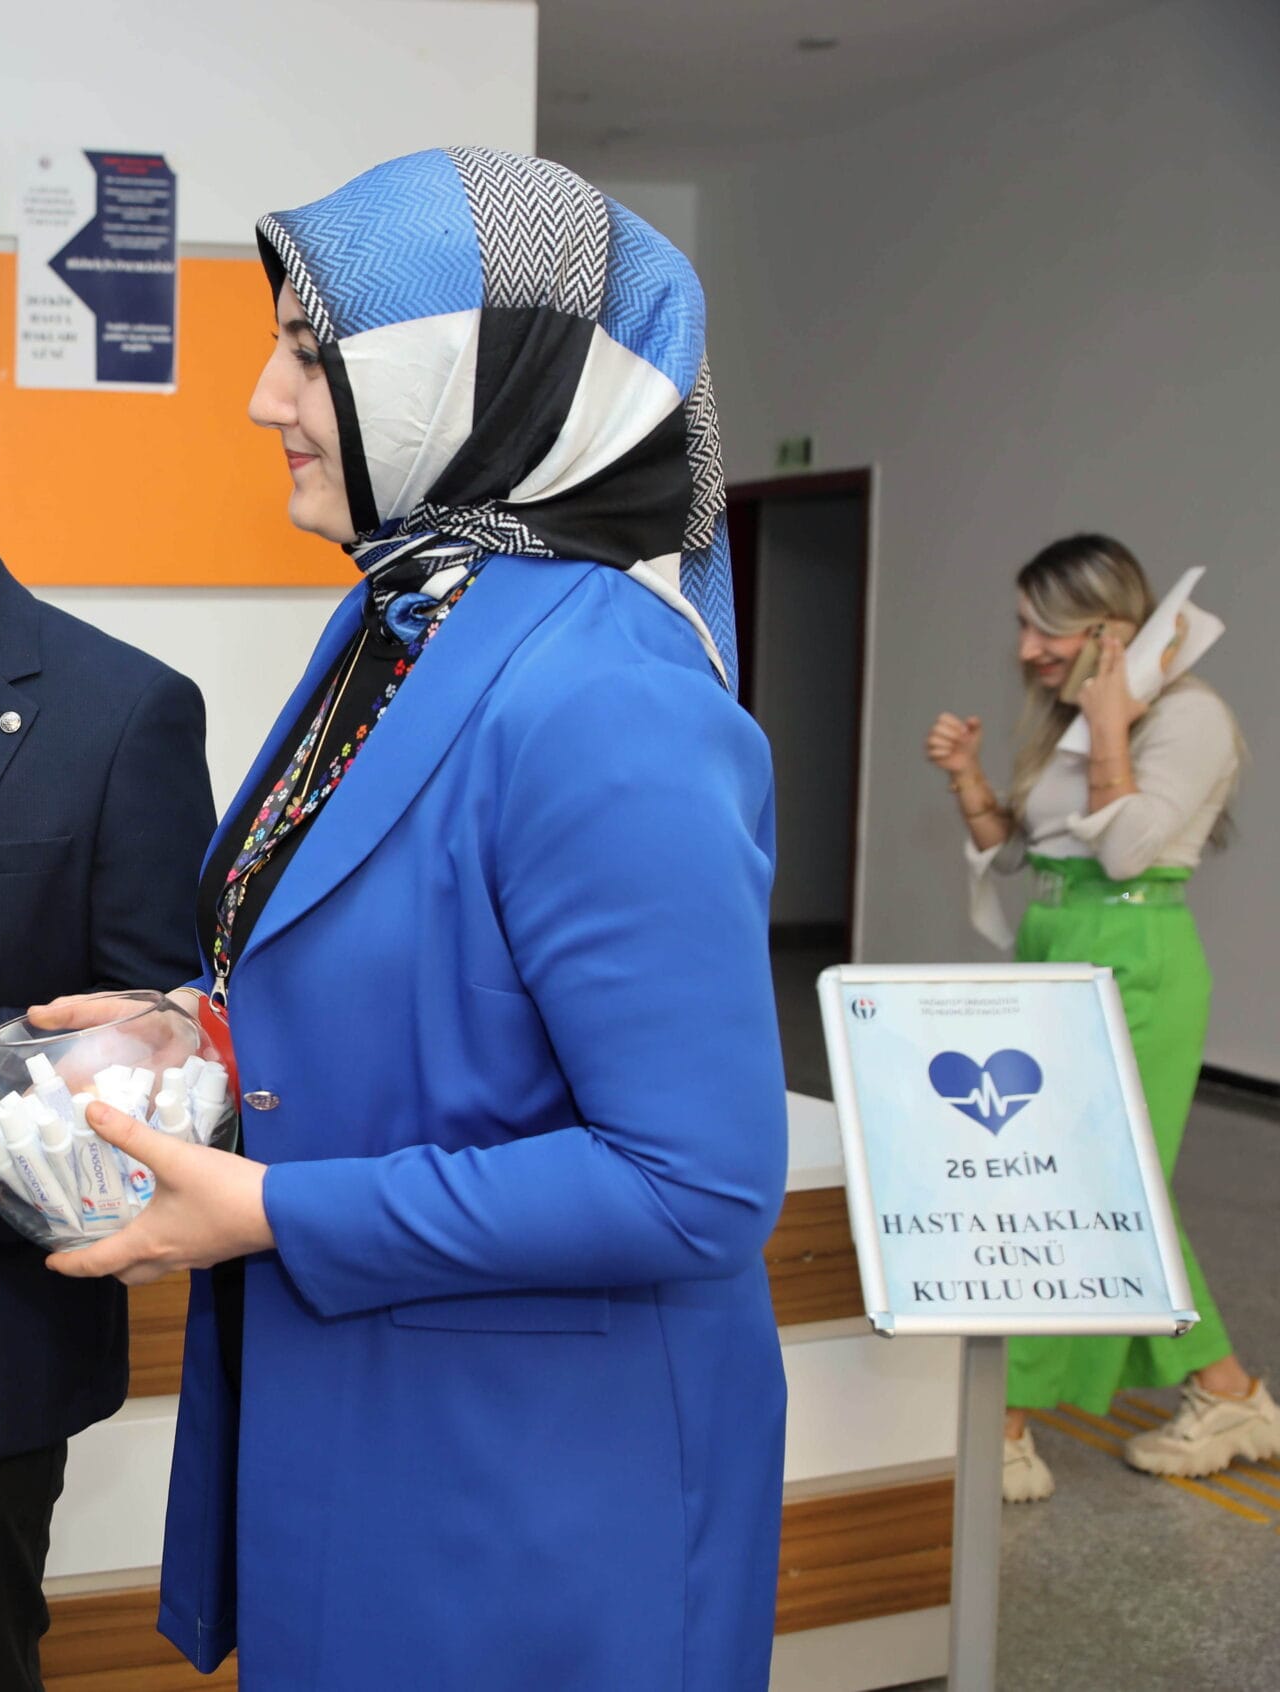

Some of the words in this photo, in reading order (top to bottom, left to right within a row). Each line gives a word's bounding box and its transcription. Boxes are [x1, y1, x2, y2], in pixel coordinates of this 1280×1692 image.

[88, 1142, 108, 1195] SENSODYNE
[946, 1159, 977, 1179] 26
[986, 1151, 1059, 1179] EKİM
[882, 1212, 987, 1235] HASTA
[996, 1209, 1145, 1234] HAKLARI
[973, 1239, 1066, 1267] GÜNÜ
[912, 1278, 1024, 1302] KUTLU
[1032, 1276, 1145, 1301] OLSUN
